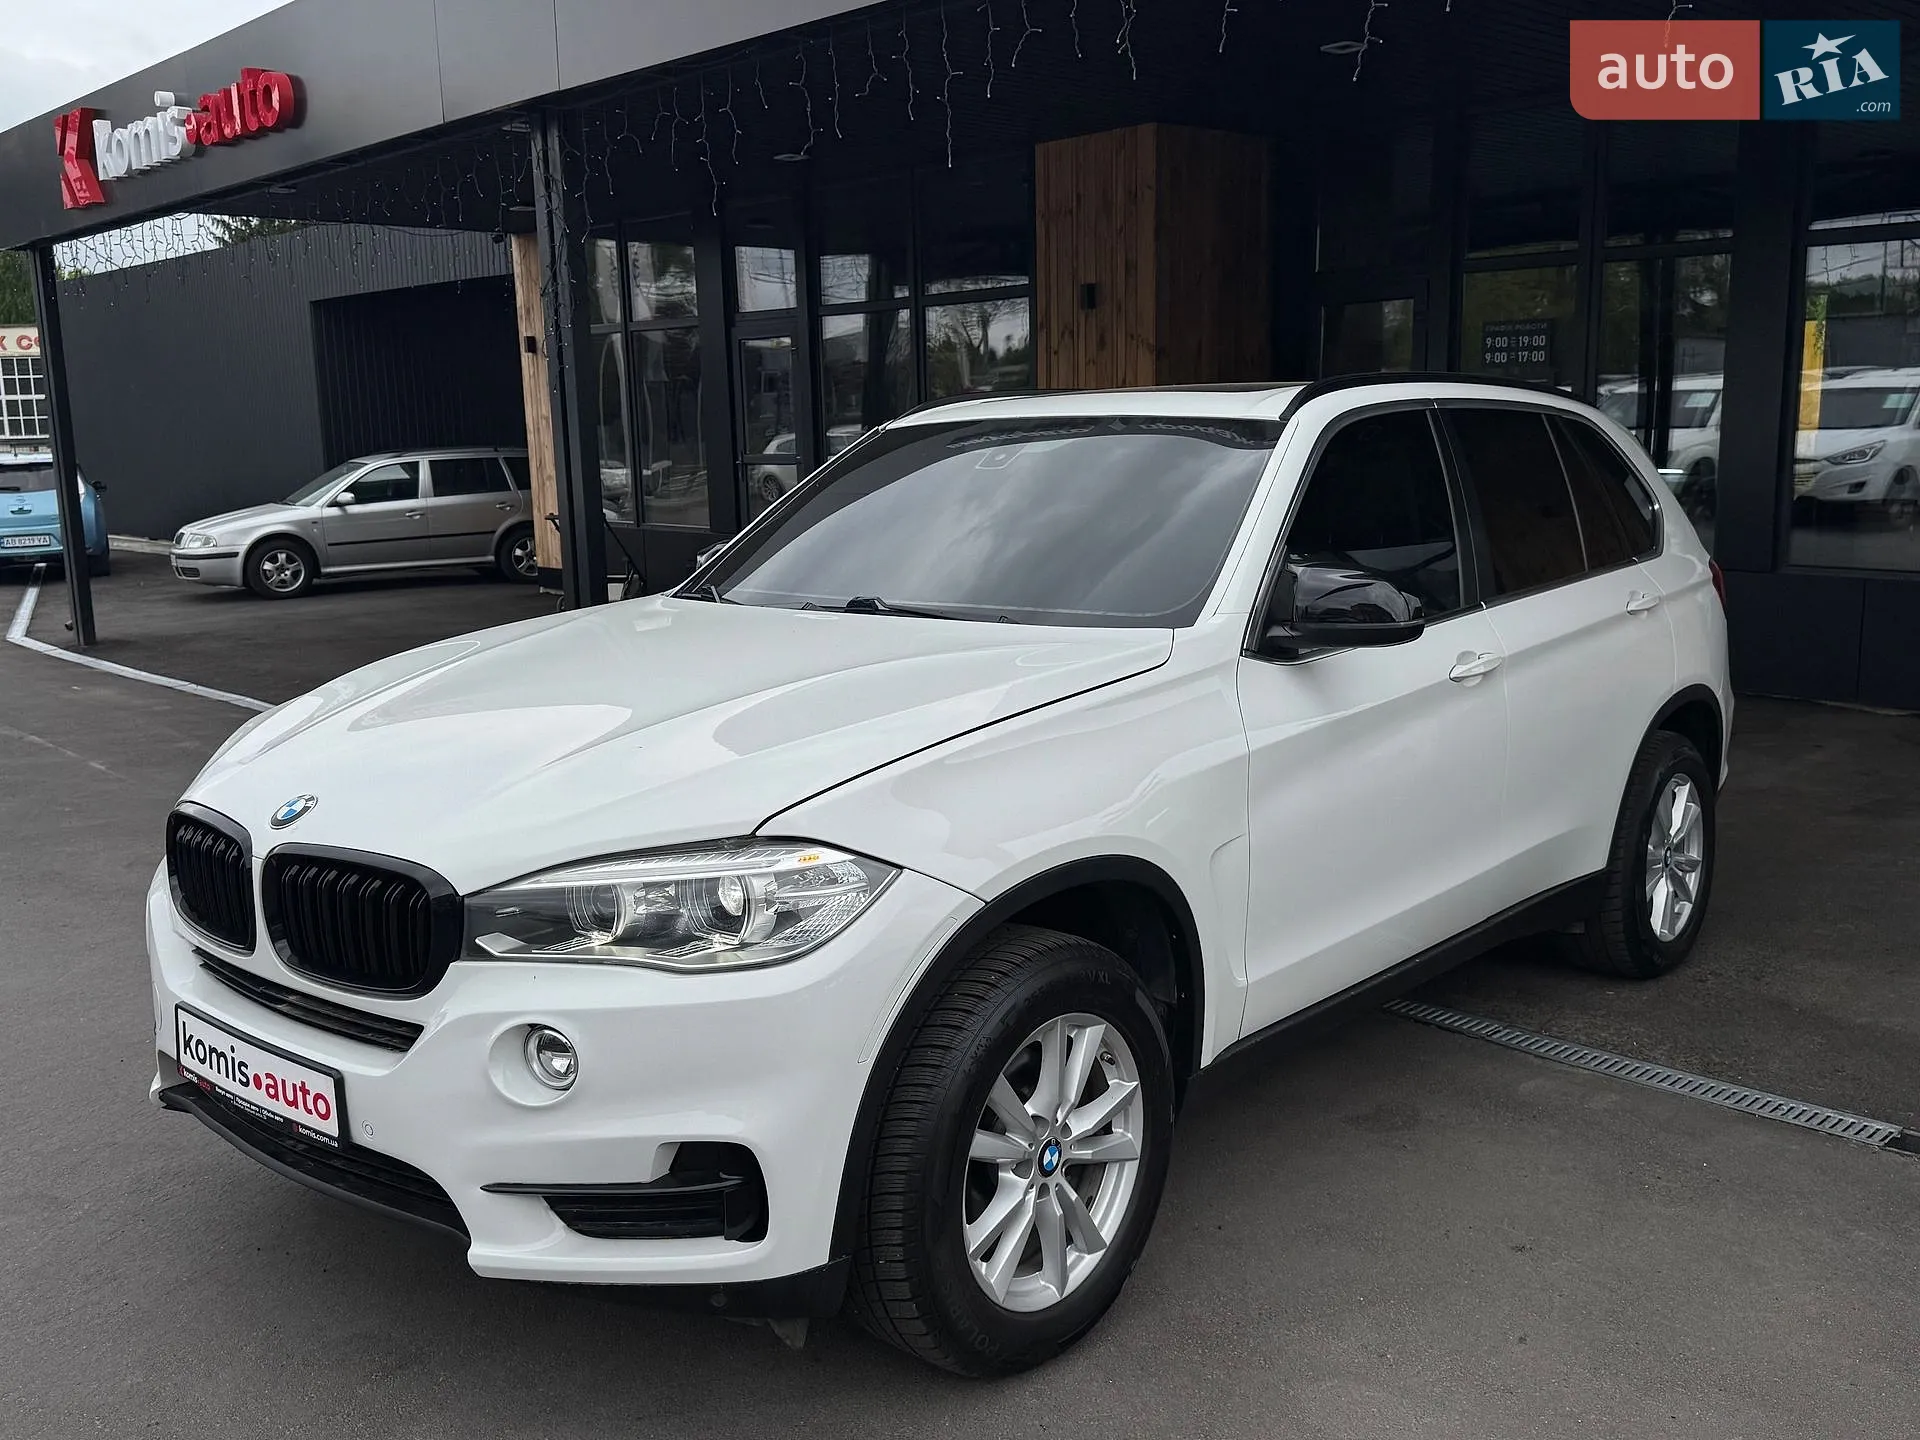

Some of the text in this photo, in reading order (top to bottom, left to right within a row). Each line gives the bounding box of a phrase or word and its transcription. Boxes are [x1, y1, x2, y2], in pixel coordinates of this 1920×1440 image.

[1486, 337, 1508, 348] 9:00
[1518, 335, 1546, 347] 19:00
[1485, 352, 1507, 364] 9:00
[1518, 351, 1545, 362] 17:00
